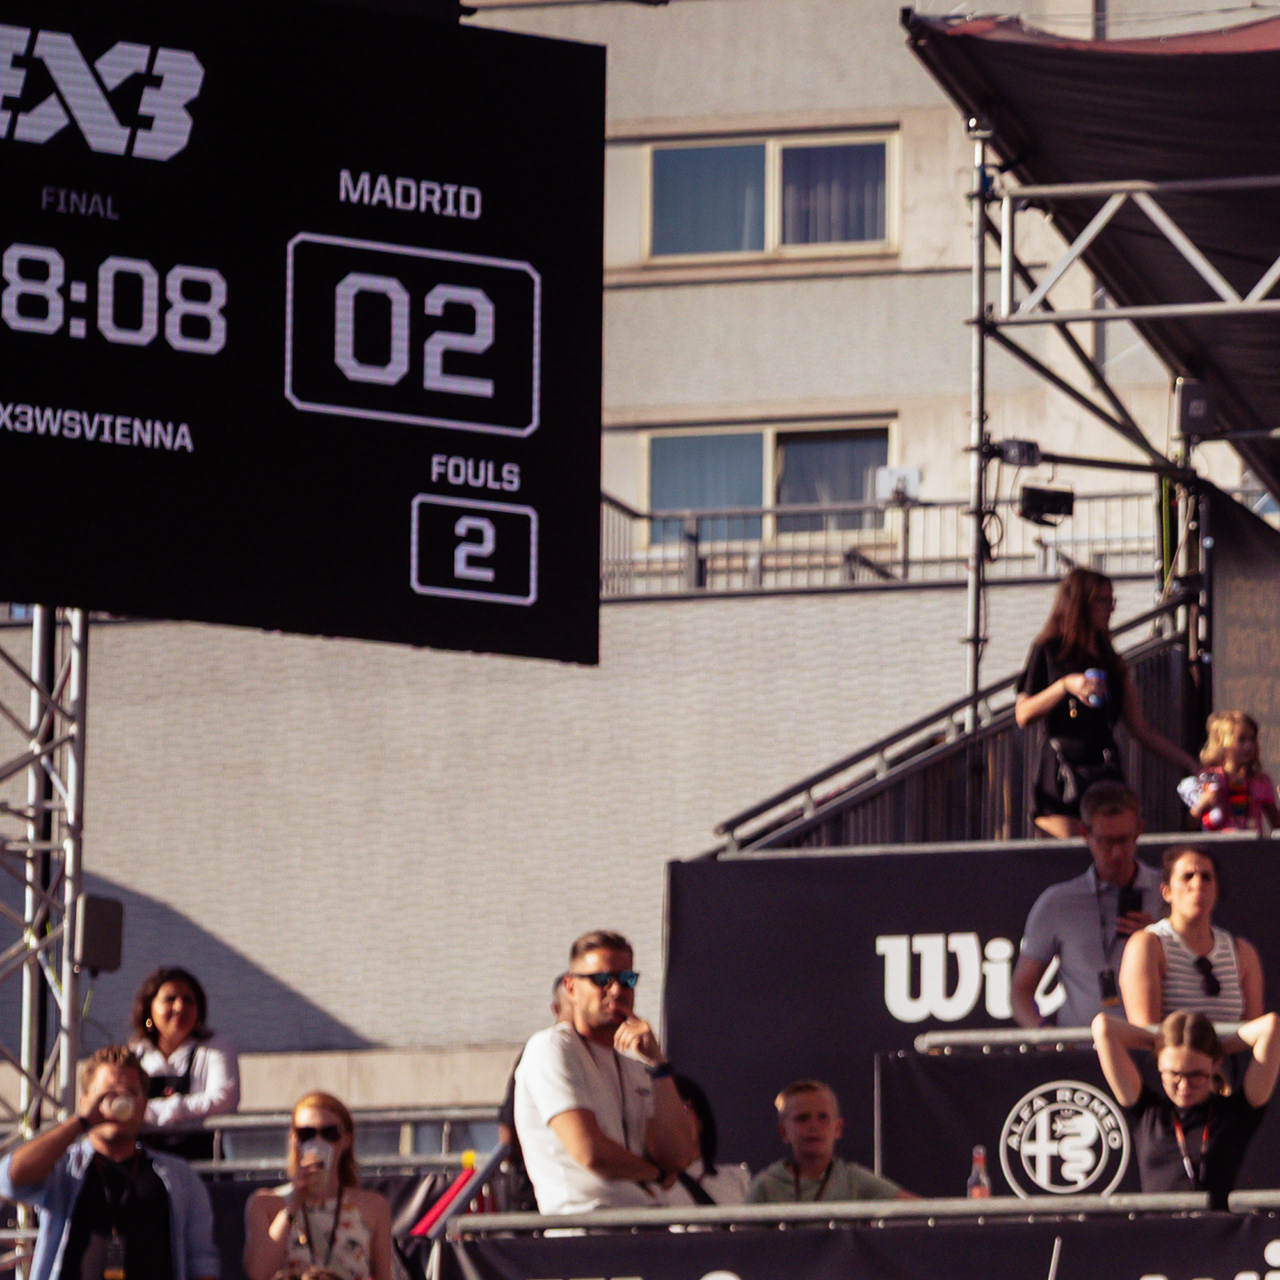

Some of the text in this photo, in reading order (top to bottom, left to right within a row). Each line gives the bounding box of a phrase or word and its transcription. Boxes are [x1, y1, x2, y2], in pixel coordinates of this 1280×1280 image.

[41, 185, 120, 221] FINAL
[339, 168, 482, 221] MADRID
[1, 242, 228, 355] 8:08
[334, 271, 495, 398] 02
[430, 454, 520, 491] FOULS
[454, 515, 496, 582] 2
[1006, 1087, 1122, 1152] ALFA ROMEO
